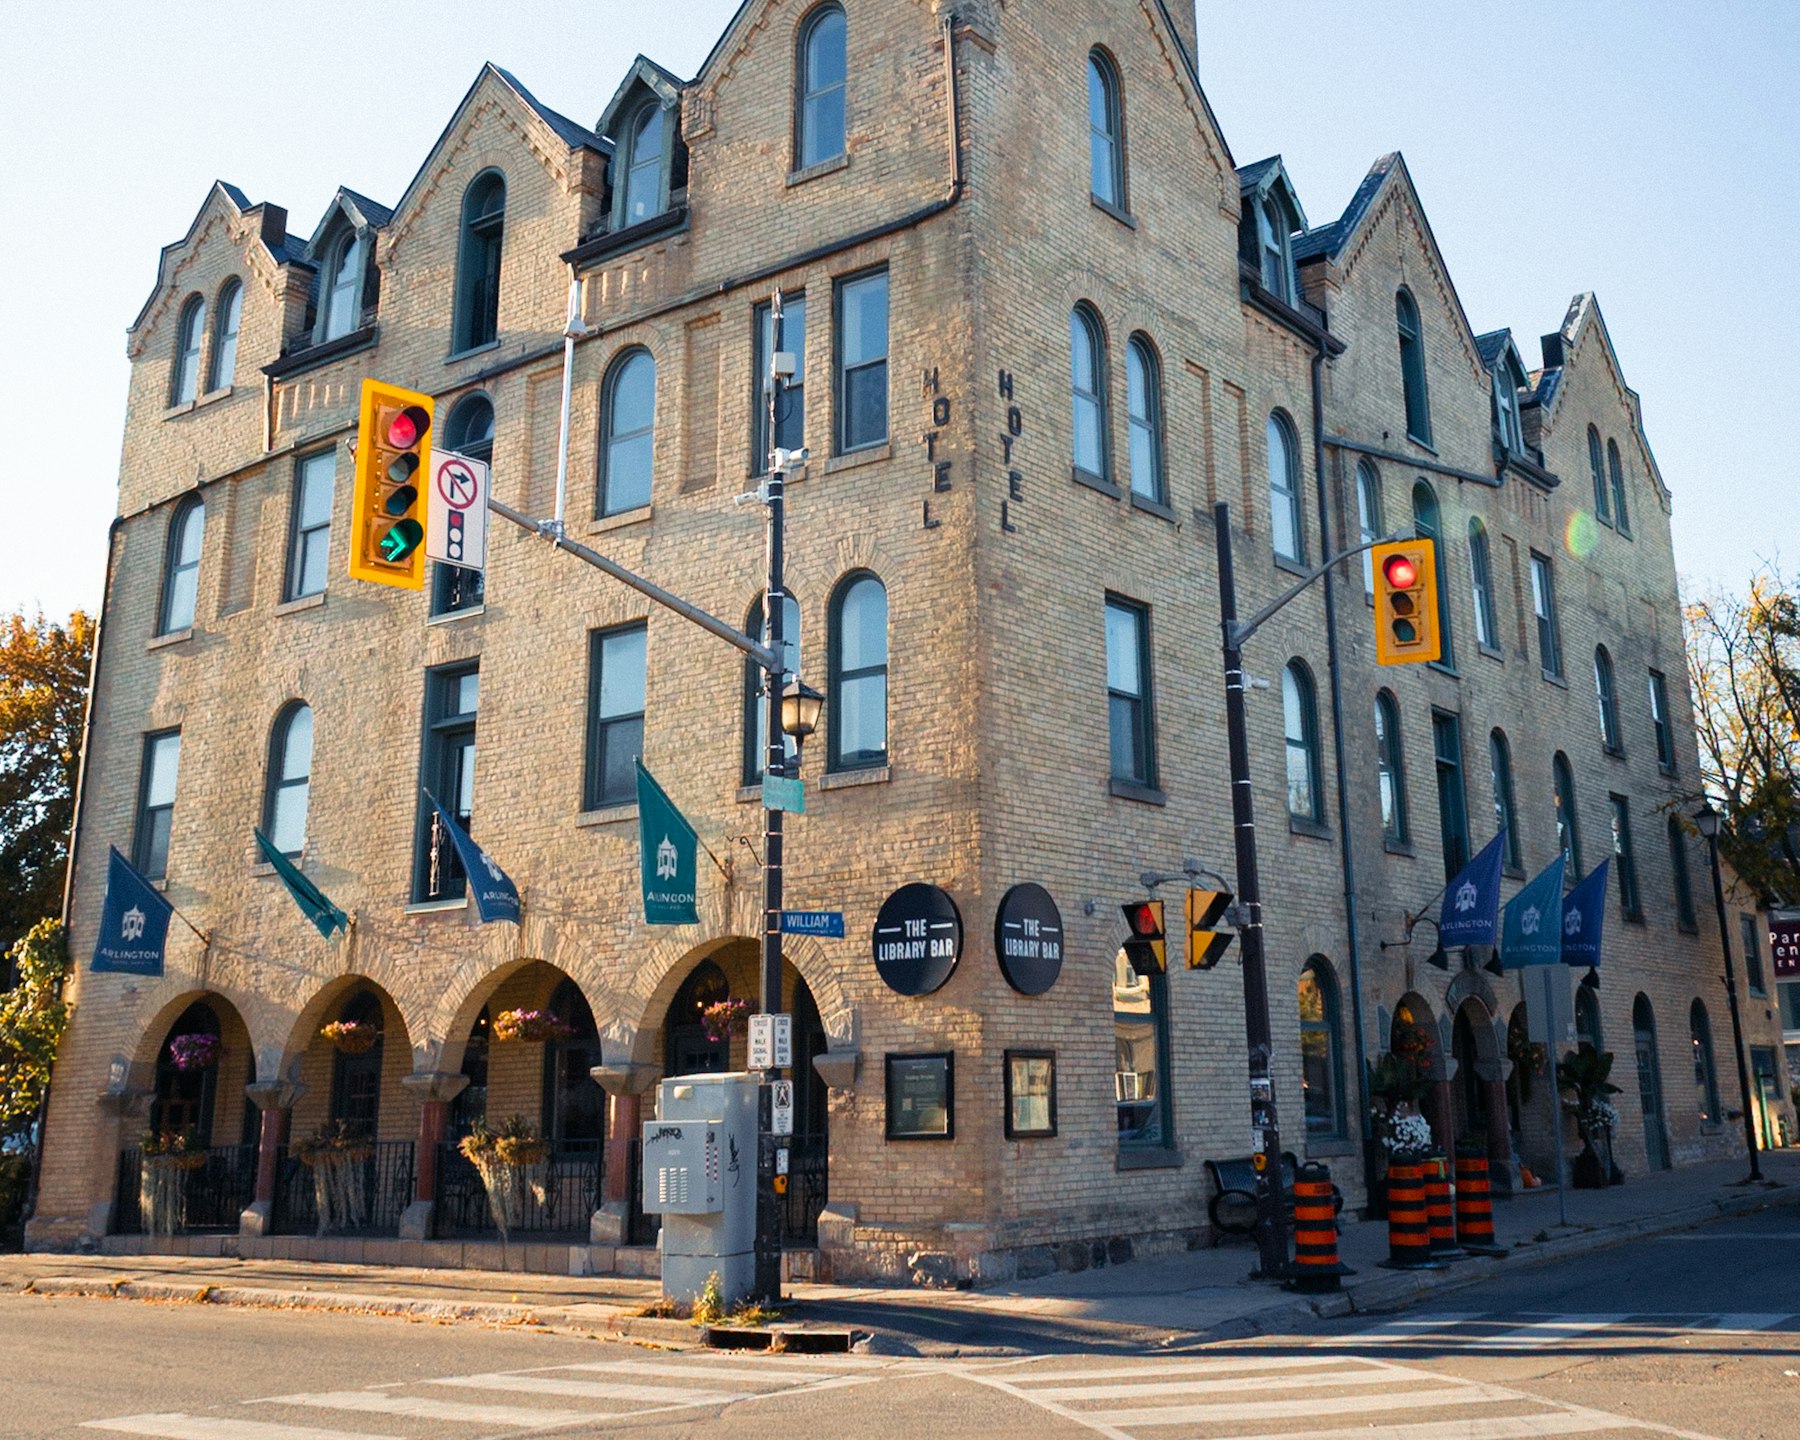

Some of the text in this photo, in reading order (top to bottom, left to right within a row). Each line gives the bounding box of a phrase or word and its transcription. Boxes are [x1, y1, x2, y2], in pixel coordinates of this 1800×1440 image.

[921, 366, 952, 529] HOTEL
[998, 369, 1023, 533] HOTEL
[787, 914, 829, 928] WILLIAM
[905, 919, 927, 938] THE
[1023, 918, 1040, 937] THE
[101, 947, 159, 960] ARLINGTON
[878, 938, 953, 961] LIBRARY BAR
[1005, 938, 1060, 960] LIBRARY BAR
